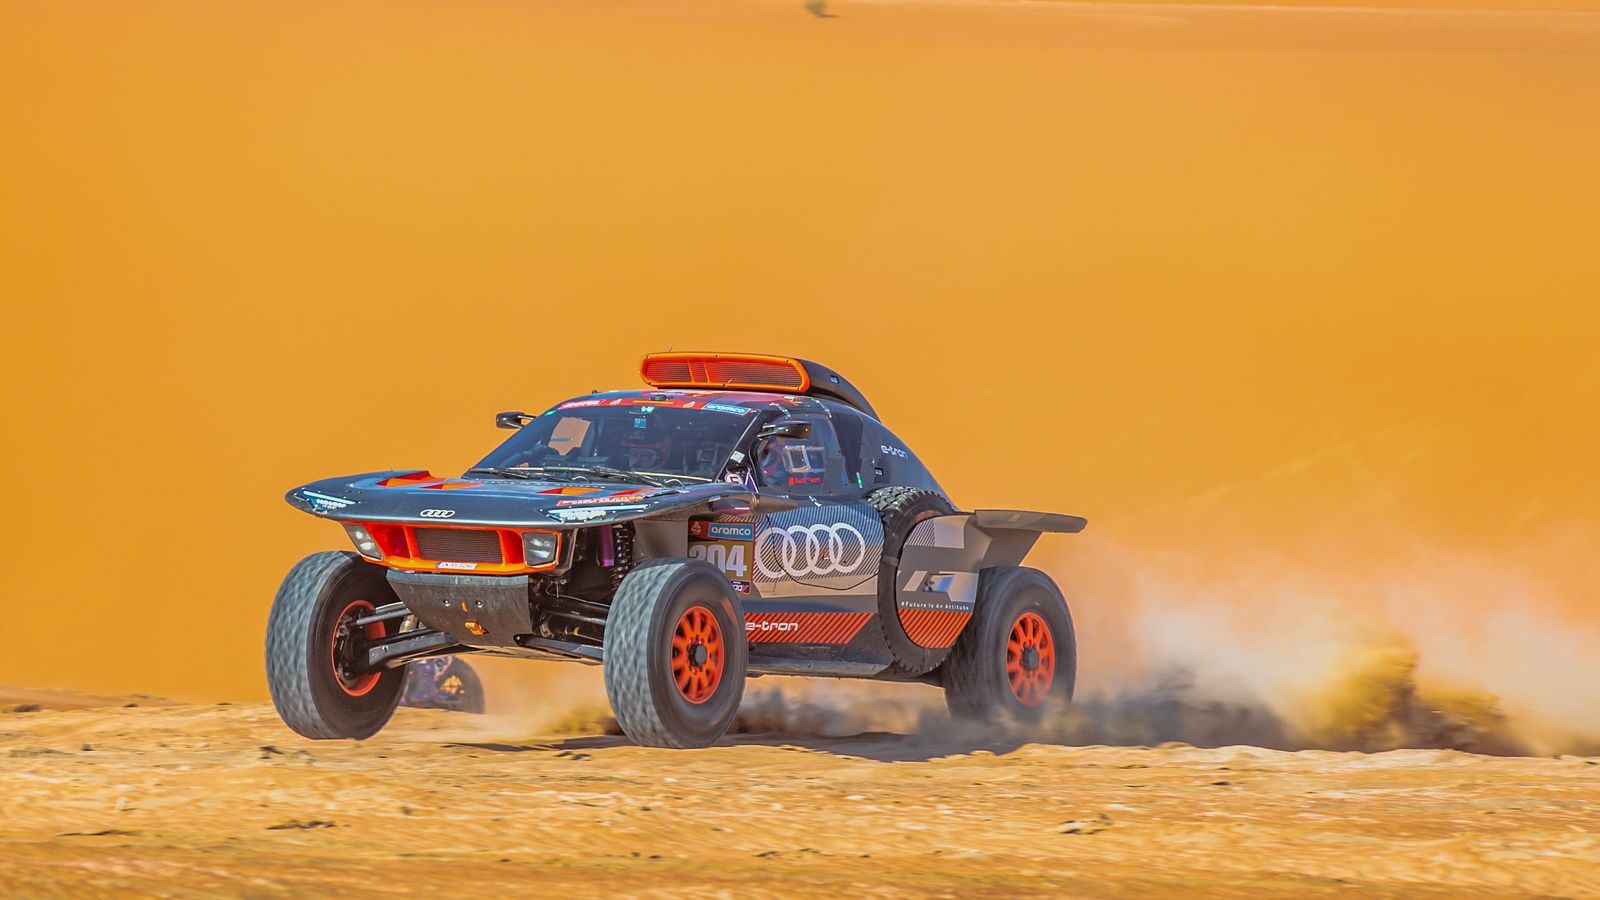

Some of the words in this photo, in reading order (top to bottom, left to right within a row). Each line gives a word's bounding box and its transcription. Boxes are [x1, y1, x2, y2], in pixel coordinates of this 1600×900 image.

[706, 403, 746, 413] aramco
[880, 444, 909, 461] e-tron
[711, 526, 751, 536] aramco
[944, 603, 969, 611] Attitude
[744, 620, 799, 632] e-tron
